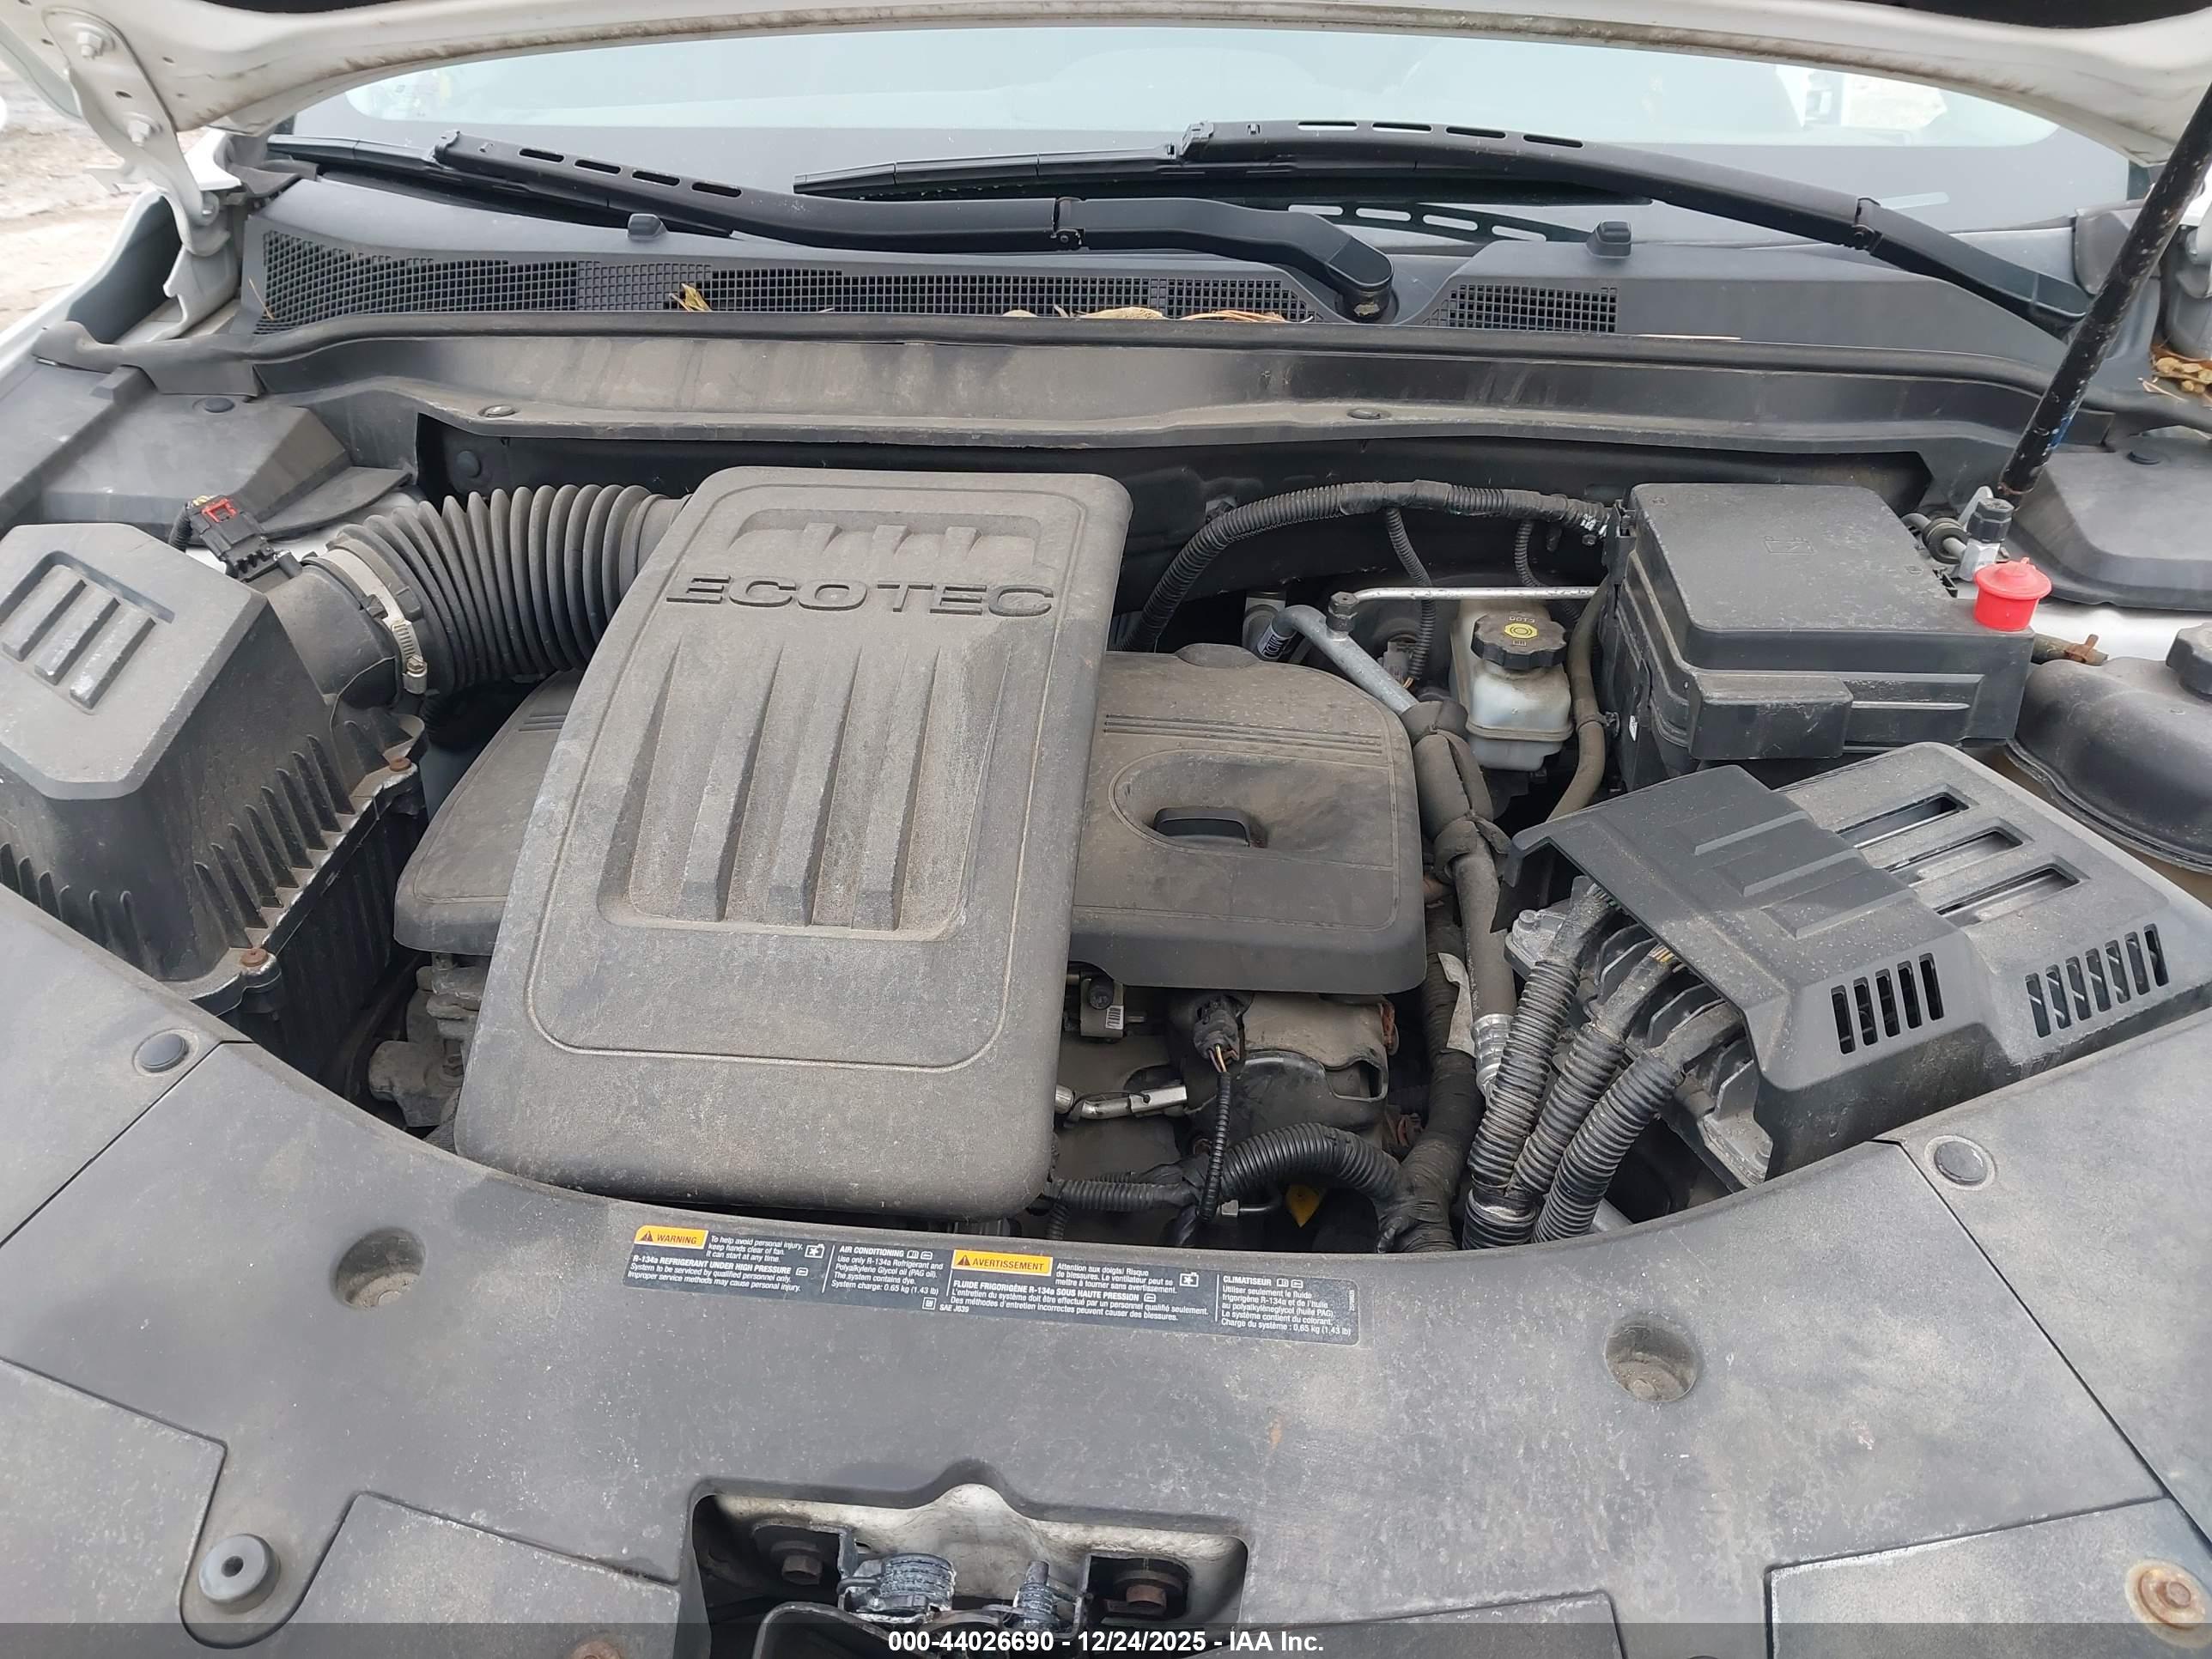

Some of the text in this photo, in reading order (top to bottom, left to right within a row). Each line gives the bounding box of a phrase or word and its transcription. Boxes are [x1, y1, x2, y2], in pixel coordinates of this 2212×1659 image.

[666, 575, 1054, 618] ECOTEC
[657, 1234, 696, 1244] WARNING
[854, 1246, 904, 1257] CONDITIONING
[633, 1255, 658, 1263] R-134a
[659, 1257, 708, 1267] REFRIGERANT
[754, 1265, 791, 1273] PRESSURE
[852, 1256, 866, 1265] only
[867, 1257, 891, 1266] R-134a
[893, 1260, 928, 1269] Refrigerant
[973, 1259, 1044, 1270] AVERTISSEMENT
[674, 1267, 702, 1275] serviced
[713, 1270, 741, 1279] qualified
[836, 1263, 876, 1273] Polyalkylene
[878, 1266, 897, 1276] Glycol
[908, 1268, 924, 1277] (PAG
[628, 1271, 657, 1280] Improper
[714, 1279, 728, 1287] may
[750, 1281, 780, 1290] personal
[781, 1284, 800, 1292] injury.
[873, 1274, 900, 1283] contains
[1066, 1272, 1099, 1280] blessures.
[1112, 1275, 1146, 1284] ventilateur
[1223, 1276, 1271, 1285] CLIMATISEUR
[831, 1279, 855, 1288] System
[858, 1281, 882, 1291] charge:
[902, 1285, 908, 1294] kg
[911, 1285, 928, 1295] (1.43
[953, 1280, 1139, 1301] FLUIDE FRIGORIGÈNE R-134a SOUS HAUTE PRESSION
[1249, 1288, 1283, 1297] seulement
[1293, 1290, 1312, 1298] fluide
[952, 1289, 987, 1297] L'entretien
[999, 1292, 1026, 1303] système
[1110, 1302, 1143, 1310] personnel
[1171, 1306, 1208, 1315] seulement.
[1223, 1294, 1259, 1304] frigorigène
[965, 1297, 998, 1307] méthodes
[1000, 1301, 1036, 1310] d'entretien
[1037, 1304, 1074, 1313] incorrectes
[1144, 1312, 1178, 1321] blessures.
[1233, 1304, 1294, 1315] polyalkylèneglycol
[1297, 1307, 1315, 1316] (huile
[1232, 1311, 1261, 1320] système
[1221, 1318, 1245, 1328] Charge
[1259, 1321, 1287, 1331] système
[1311, 1325, 1320, 1334] kg
[1342, 1328, 1351, 1336] lb)
